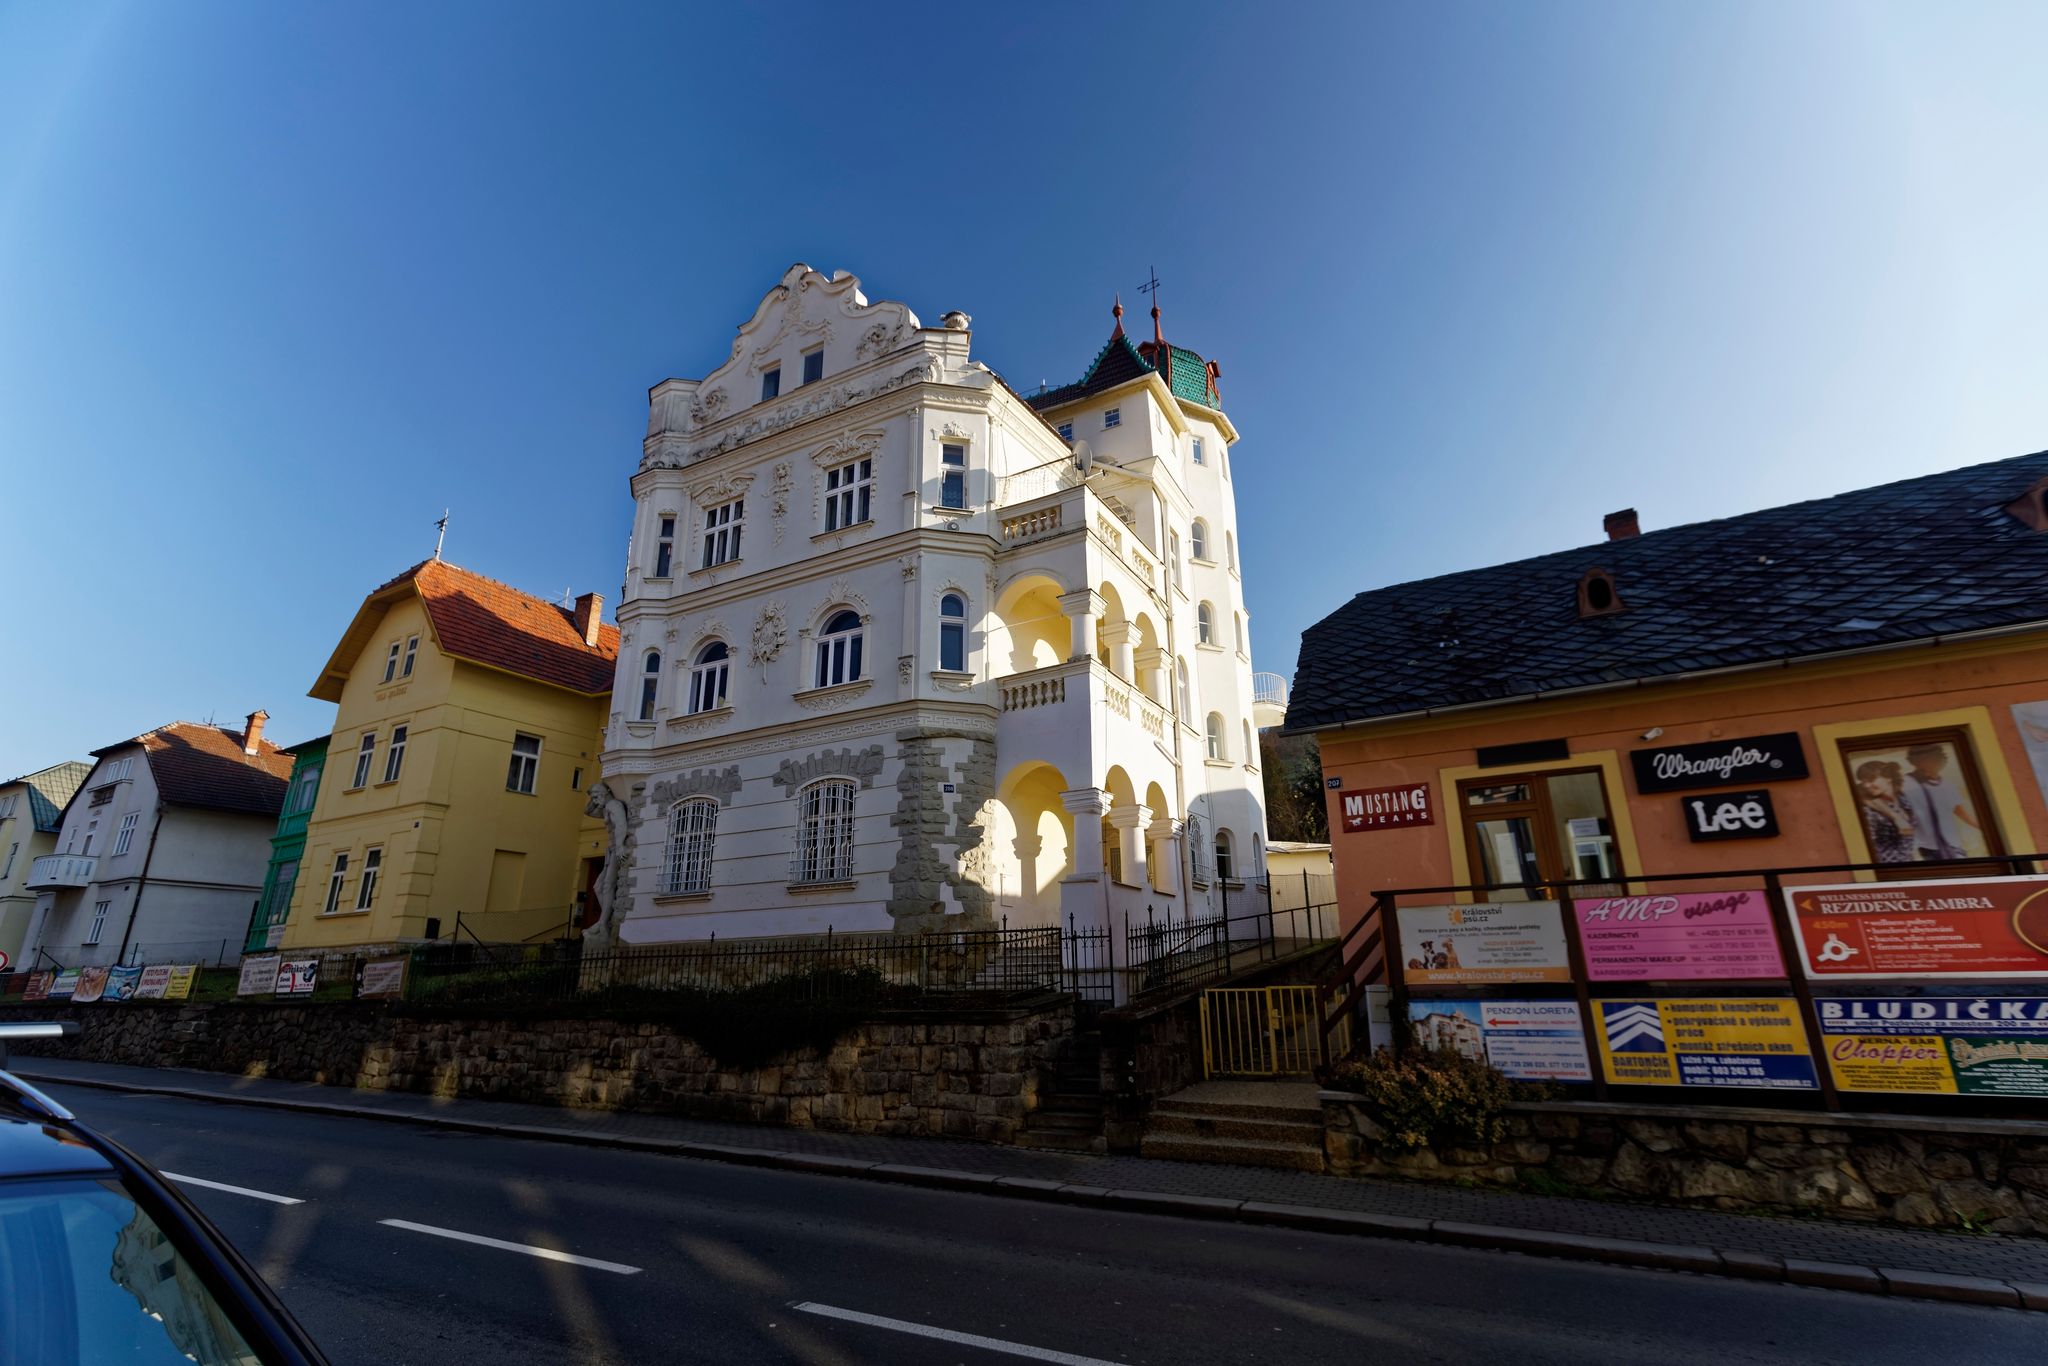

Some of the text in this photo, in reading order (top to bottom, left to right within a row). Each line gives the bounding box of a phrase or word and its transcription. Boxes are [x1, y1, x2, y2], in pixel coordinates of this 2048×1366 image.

[1653, 746, 1770, 779] Wrangler
[1328, 780, 1340, 788] 207
[1345, 789, 1426, 817] MUSTANG
[1368, 812, 1428, 824] JEANS
[1691, 800, 1767, 833] Lee
[1817, 890, 1908, 902] WELLNESS HOTEL
[1462, 906, 1502, 916] Království
[1585, 892, 1751, 924] AMP visage
[1820, 897, 1995, 914] REZIDENCE AMBRA
[1486, 1007, 1575, 1015] PENZION LORETA
[1882, 1019, 1929, 1028] Pozlovice
[1996, 1020, 2017, 1028] 200
[1832, 1038, 1940, 1063] Chopper
